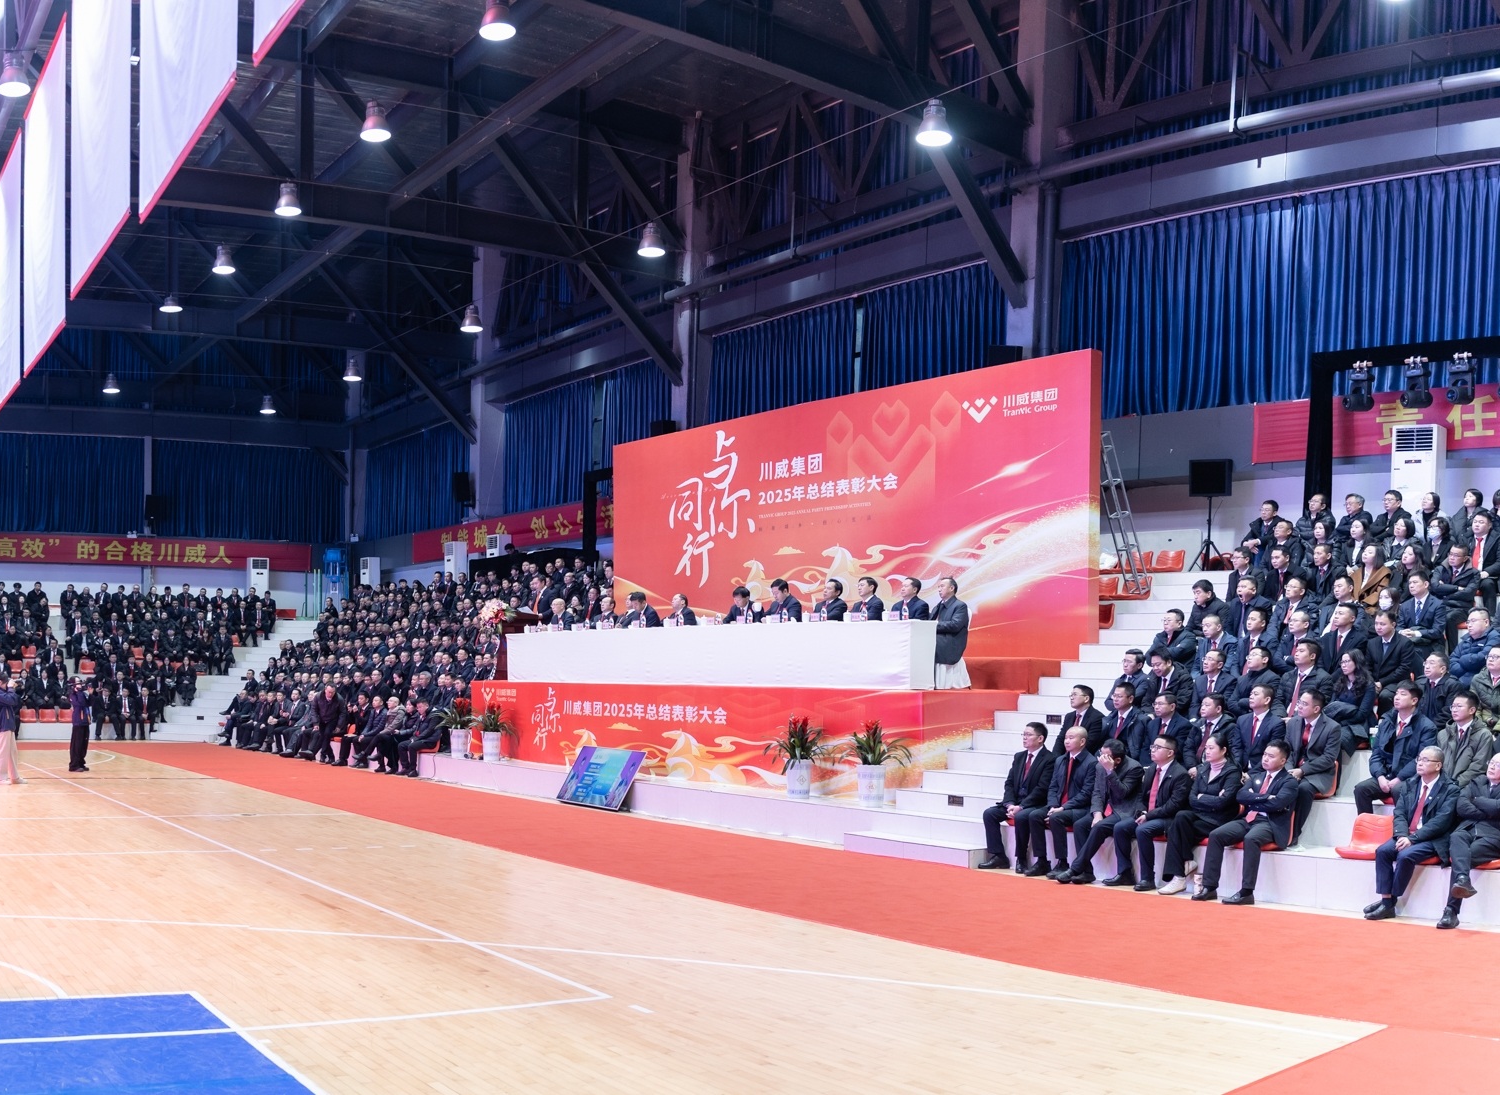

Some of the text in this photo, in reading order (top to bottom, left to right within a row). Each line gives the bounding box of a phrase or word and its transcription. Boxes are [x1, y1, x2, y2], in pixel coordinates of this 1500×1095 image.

[1002, 387, 1058, 408] 川威集团
[1034, 403, 1058, 414] Group
[758, 452, 823, 482] 川威集团
[758, 472, 899, 505] 2025年总结表彰大会
[562, 699, 728, 725] 川威集团2025年总结表彰大会
